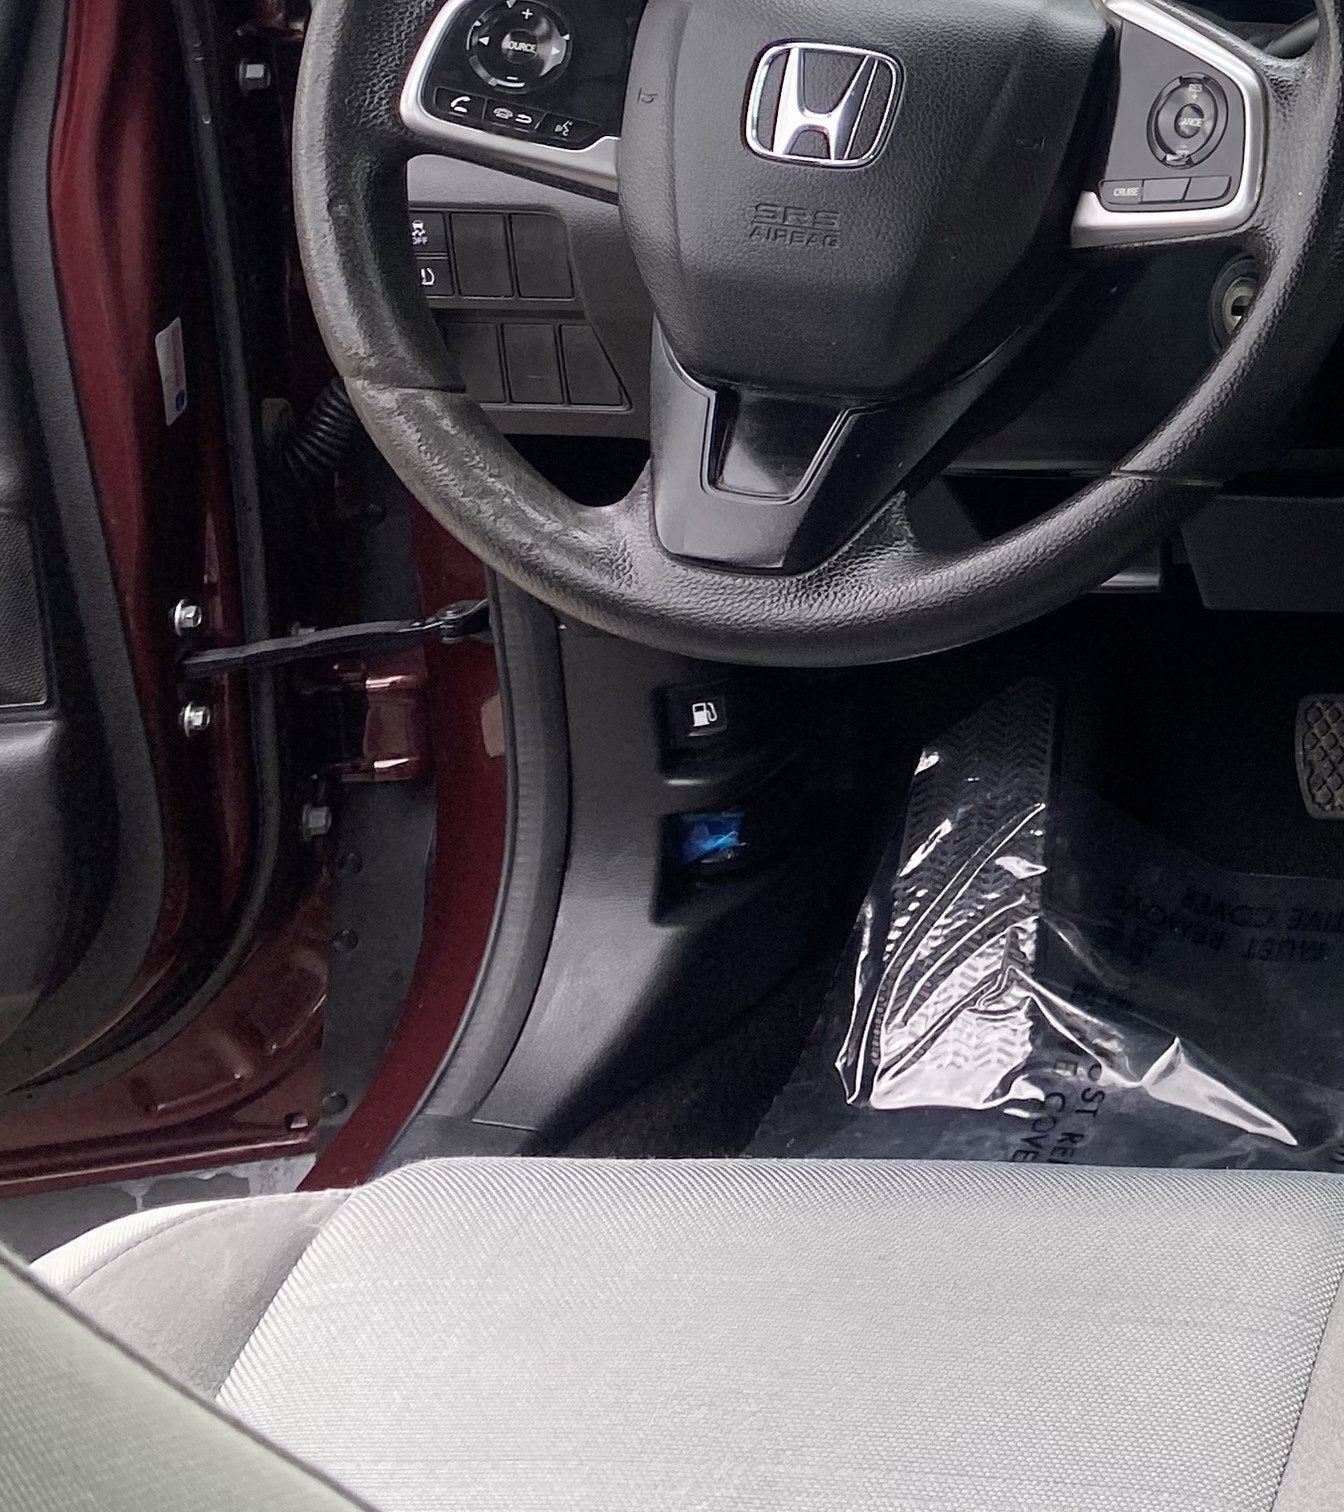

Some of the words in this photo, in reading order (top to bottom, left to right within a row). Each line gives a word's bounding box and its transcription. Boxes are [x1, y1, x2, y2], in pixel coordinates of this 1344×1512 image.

[1113, 188, 1139, 197] CRUISE
[752, 203, 840, 227] SRS
[749, 226, 840, 248] AIRBAG
[1011, 1091, 1066, 1162] COVE
